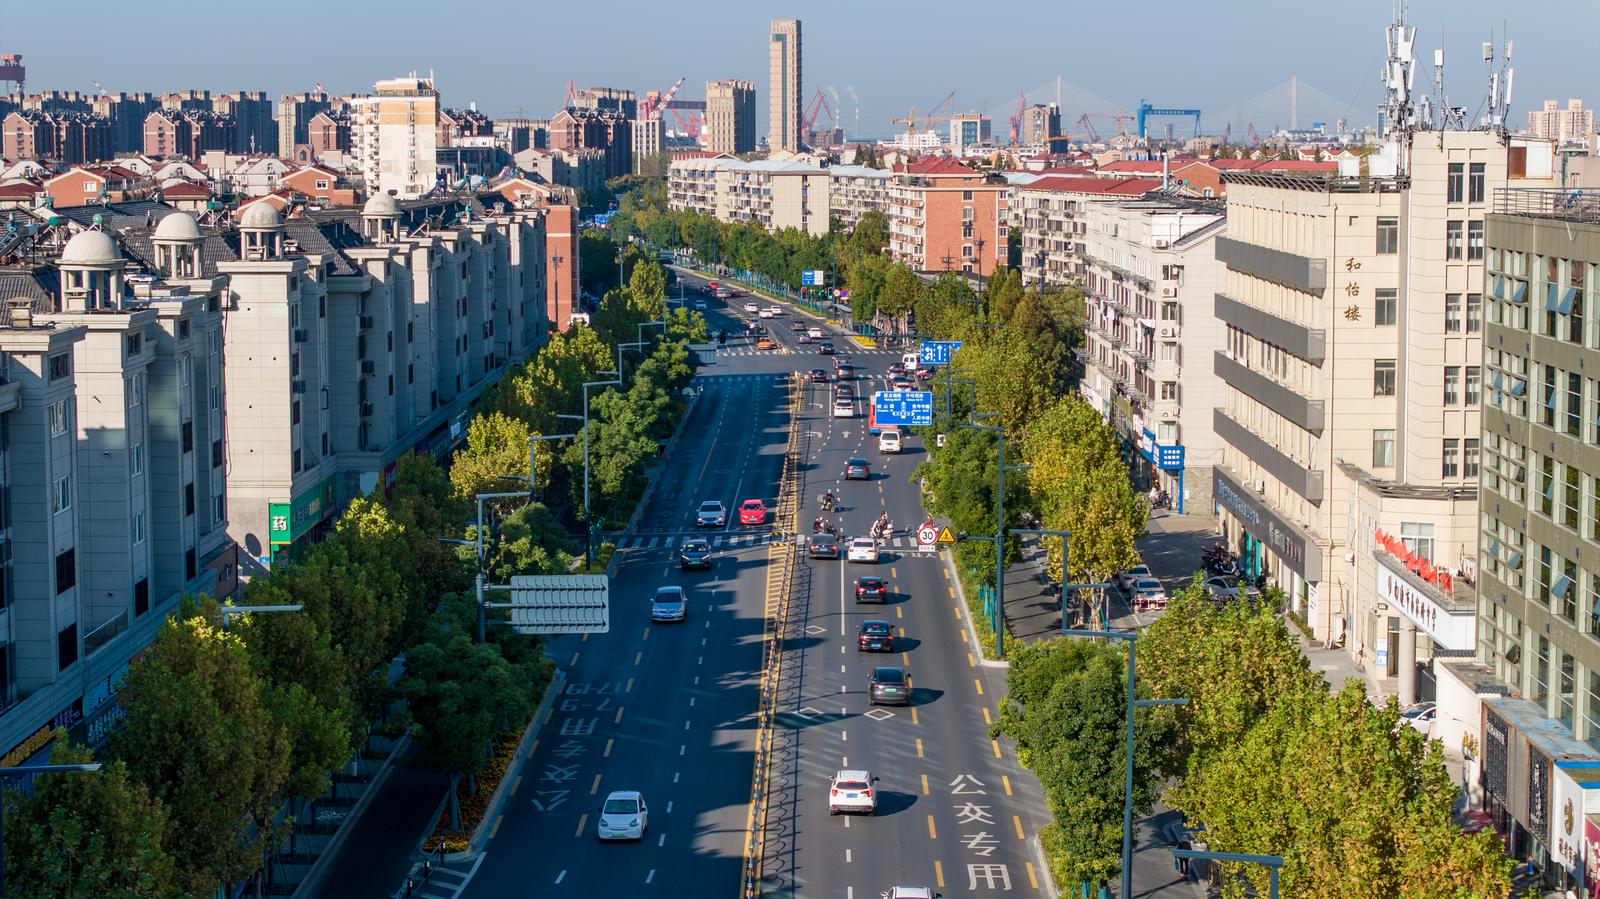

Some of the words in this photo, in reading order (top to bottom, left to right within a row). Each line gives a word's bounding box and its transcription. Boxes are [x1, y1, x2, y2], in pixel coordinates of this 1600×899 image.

[1344, 257, 1362, 322] 和怡楼
[272, 516, 287, 531] 药
[922, 531, 934, 540] 30
[560, 699, 613, 712] 7-9
[531, 717, 600, 811] 公交专用
[949, 774, 1012, 891] 公交专用
